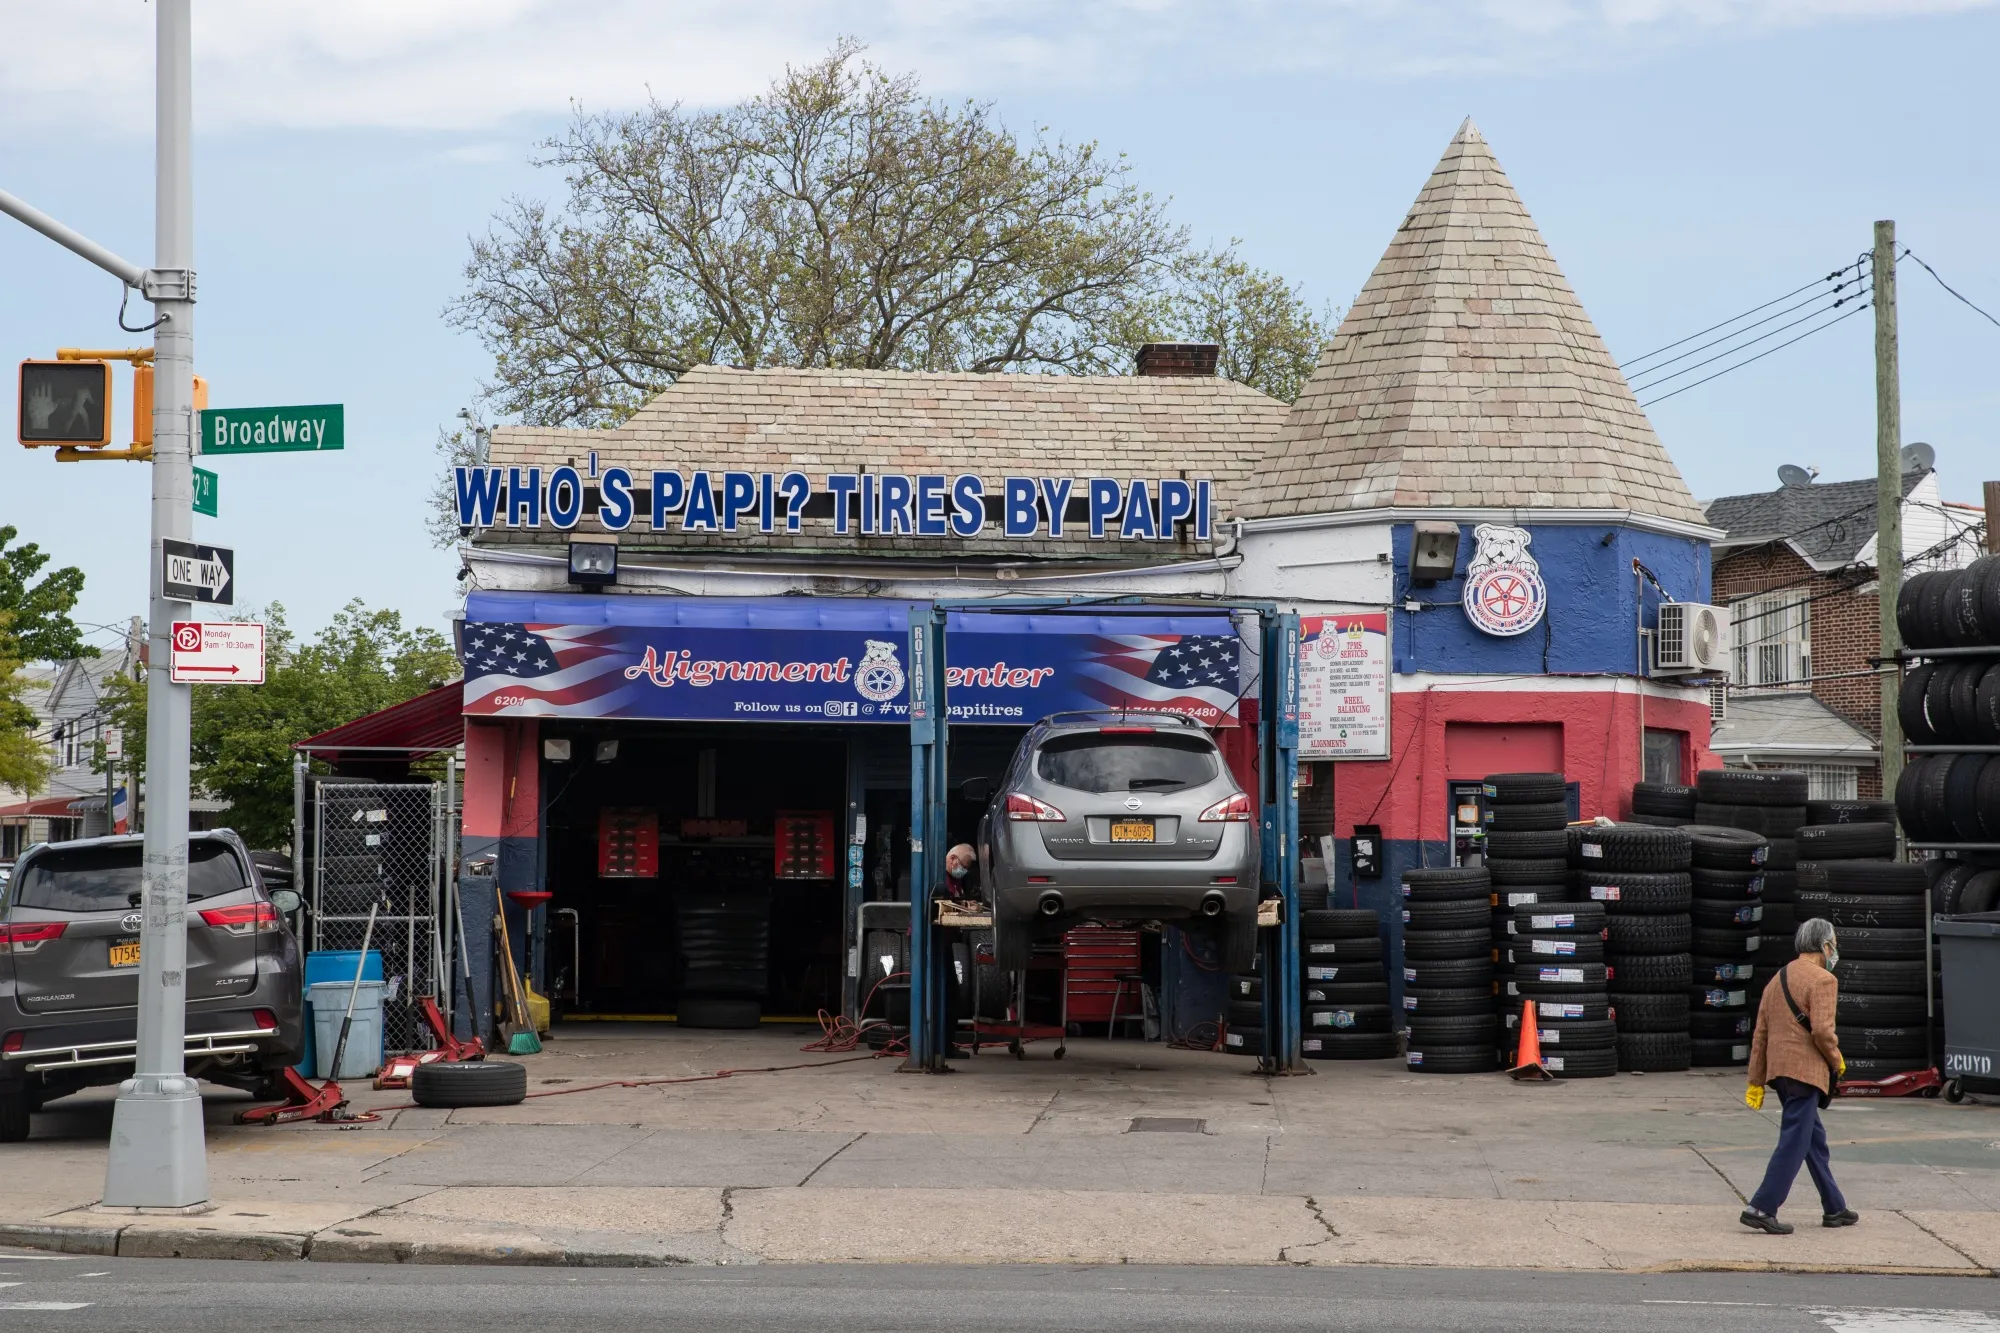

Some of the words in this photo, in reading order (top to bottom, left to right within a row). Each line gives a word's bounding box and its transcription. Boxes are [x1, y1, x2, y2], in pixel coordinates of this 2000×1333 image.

[214, 414, 326, 449] Broadway
[203, 475, 209, 496] St
[454, 451, 635, 531] WHO'S
[651, 470, 811, 534] PAPI?
[827, 473, 986, 537] TIRES
[1004, 476, 1073, 538] BY
[1089, 477, 1212, 540] PAPI
[172, 558, 191, 582] ONE
[200, 562, 222, 586] WAY
[204, 630, 231, 639] Monday
[204, 641, 219, 649] 9am
[225, 641, 255, 649] 10:30am
[1340, 650, 1368, 658] SERVICES
[624, 645, 852, 687] Alignment
[908, 661, 1054, 687] enter
[915, 626, 923, 700] ROTARY
[1288, 629, 1296, 703] ROTARY
[494, 696, 525, 706] 6201
[1344, 696, 1364, 704] WHEEL
[735, 701, 780, 713] Follow
[785, 705, 801, 714] us
[806, 705, 822, 714] on
[913, 702, 925, 710] LIFT
[1285, 704, 1296, 713] LIFT
[1338, 705, 1370, 713] BALANCING
[1311, 740, 1346, 748] ALIGNMENTS
[27, 993, 75, 1002] HIGHLANDER
[1946, 1053, 1991, 1074] 2CUYD
[1846, 1087, 1880, 1095] Snap-on
[277, 1110, 302, 1119] Snap-on
